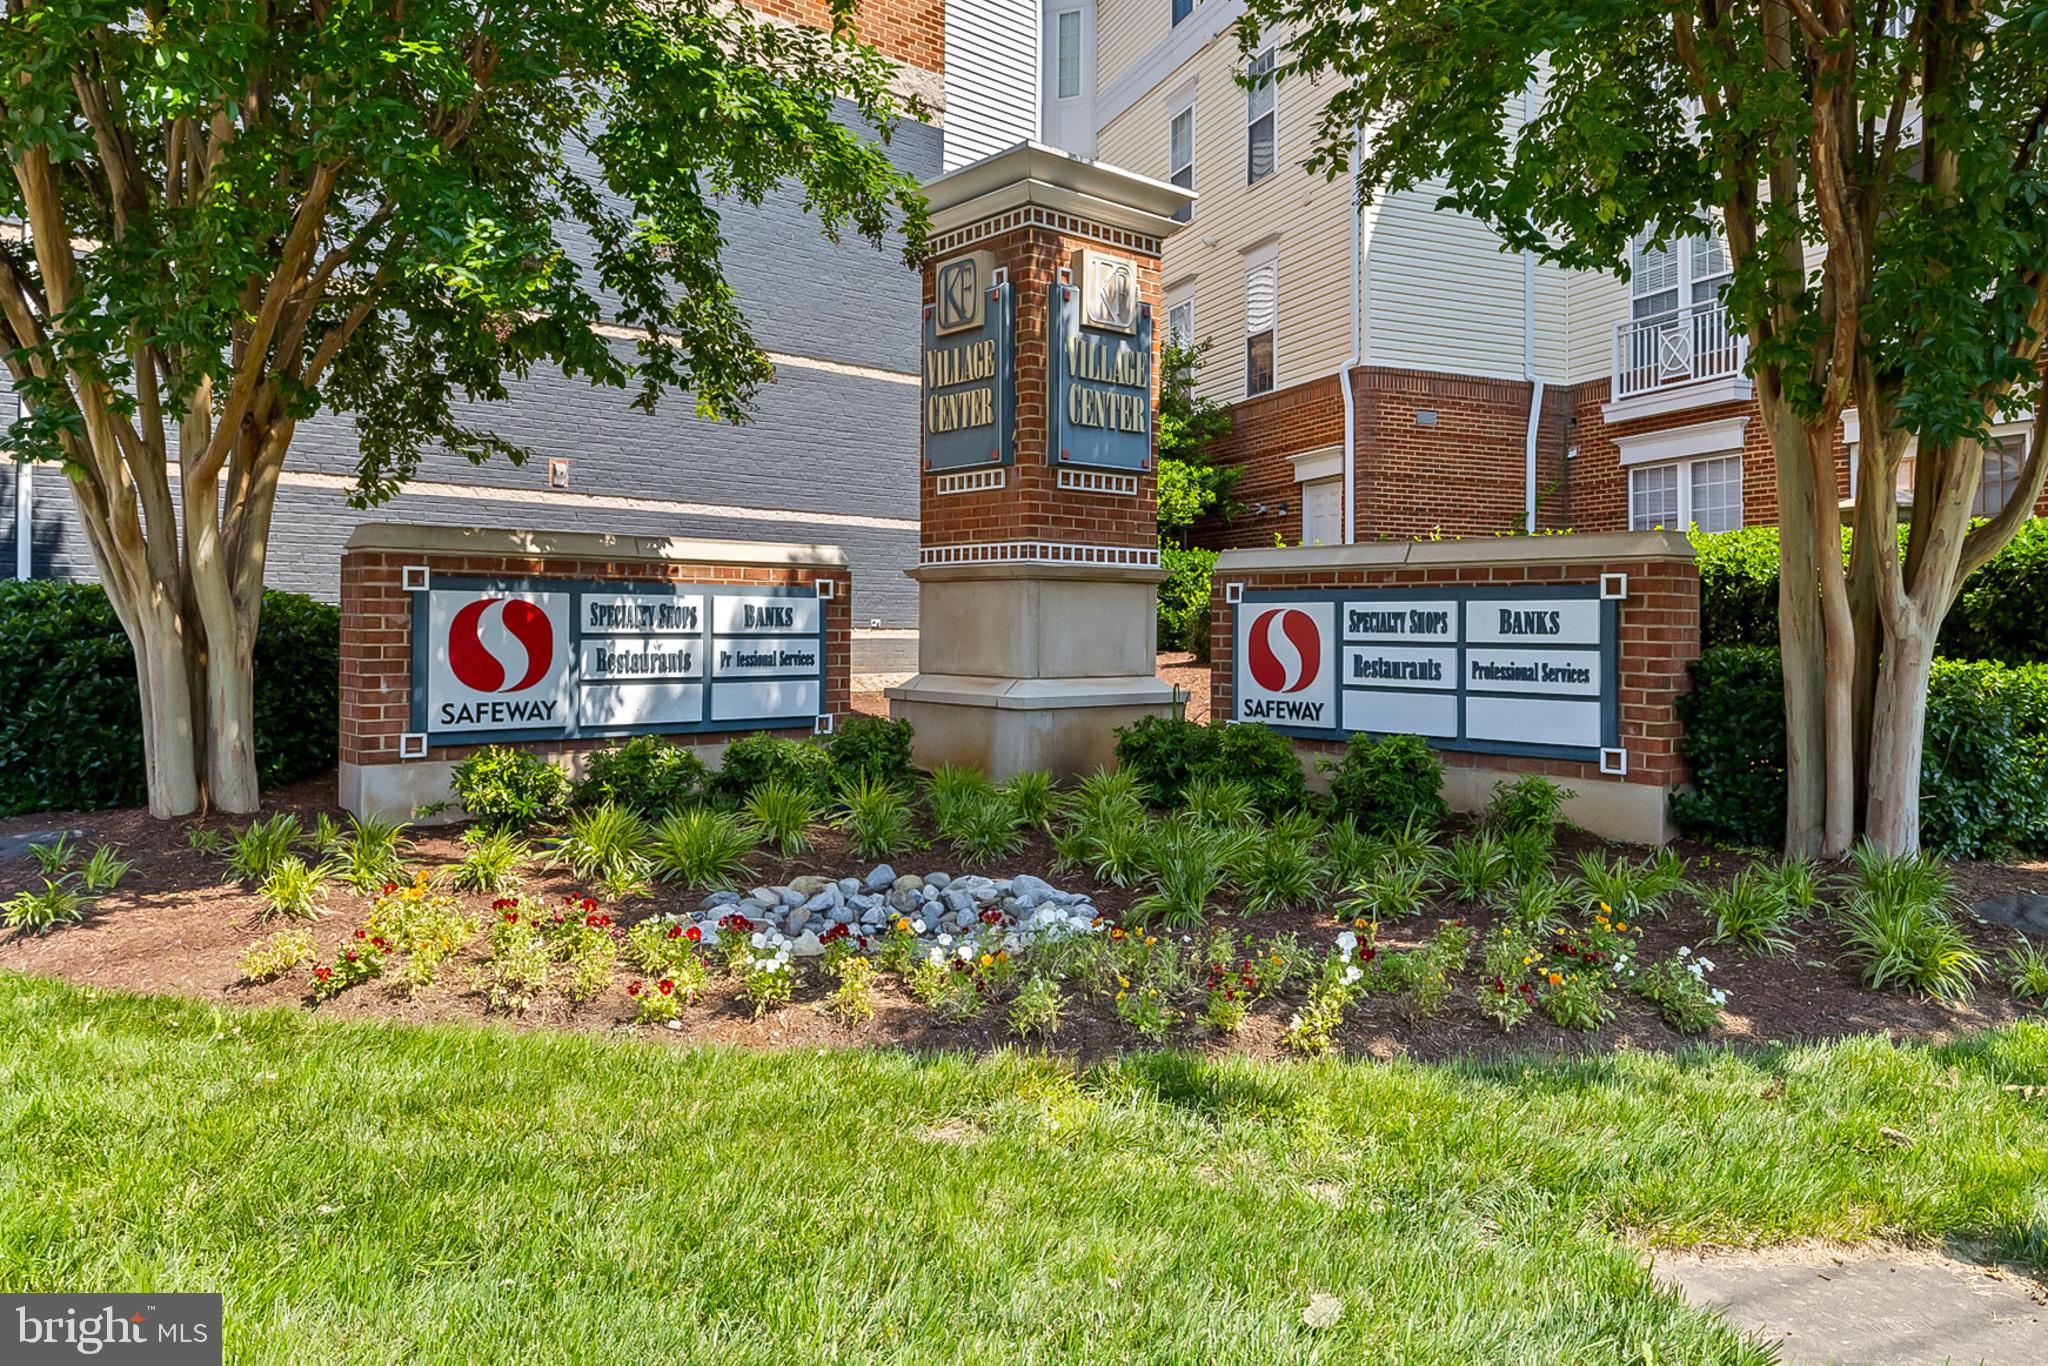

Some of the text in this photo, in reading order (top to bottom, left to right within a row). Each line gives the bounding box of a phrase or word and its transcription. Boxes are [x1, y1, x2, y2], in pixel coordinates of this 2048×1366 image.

[926, 338, 996, 389] VILLAGE
[1066, 335, 1148, 388] VILLAGE
[928, 387, 995, 433] CENTER
[1068, 383, 1147, 433] CENTER
[590, 602, 698, 630] SPECIALTY SHOPS
[743, 604, 794, 629] BANKS
[1349, 609, 1448, 634] SPECIALTY SHOPS
[1498, 608, 1561, 635] BANKS
[595, 647, 692, 675] Restaurants
[720, 650, 815, 670] Prfessional Services
[1353, 654, 1442, 681] Restaurants
[1471, 660, 1591, 684] Professional Services
[440, 700, 558, 725] SAFEWAY
[1243, 698, 1326, 722] SAFEWAY
